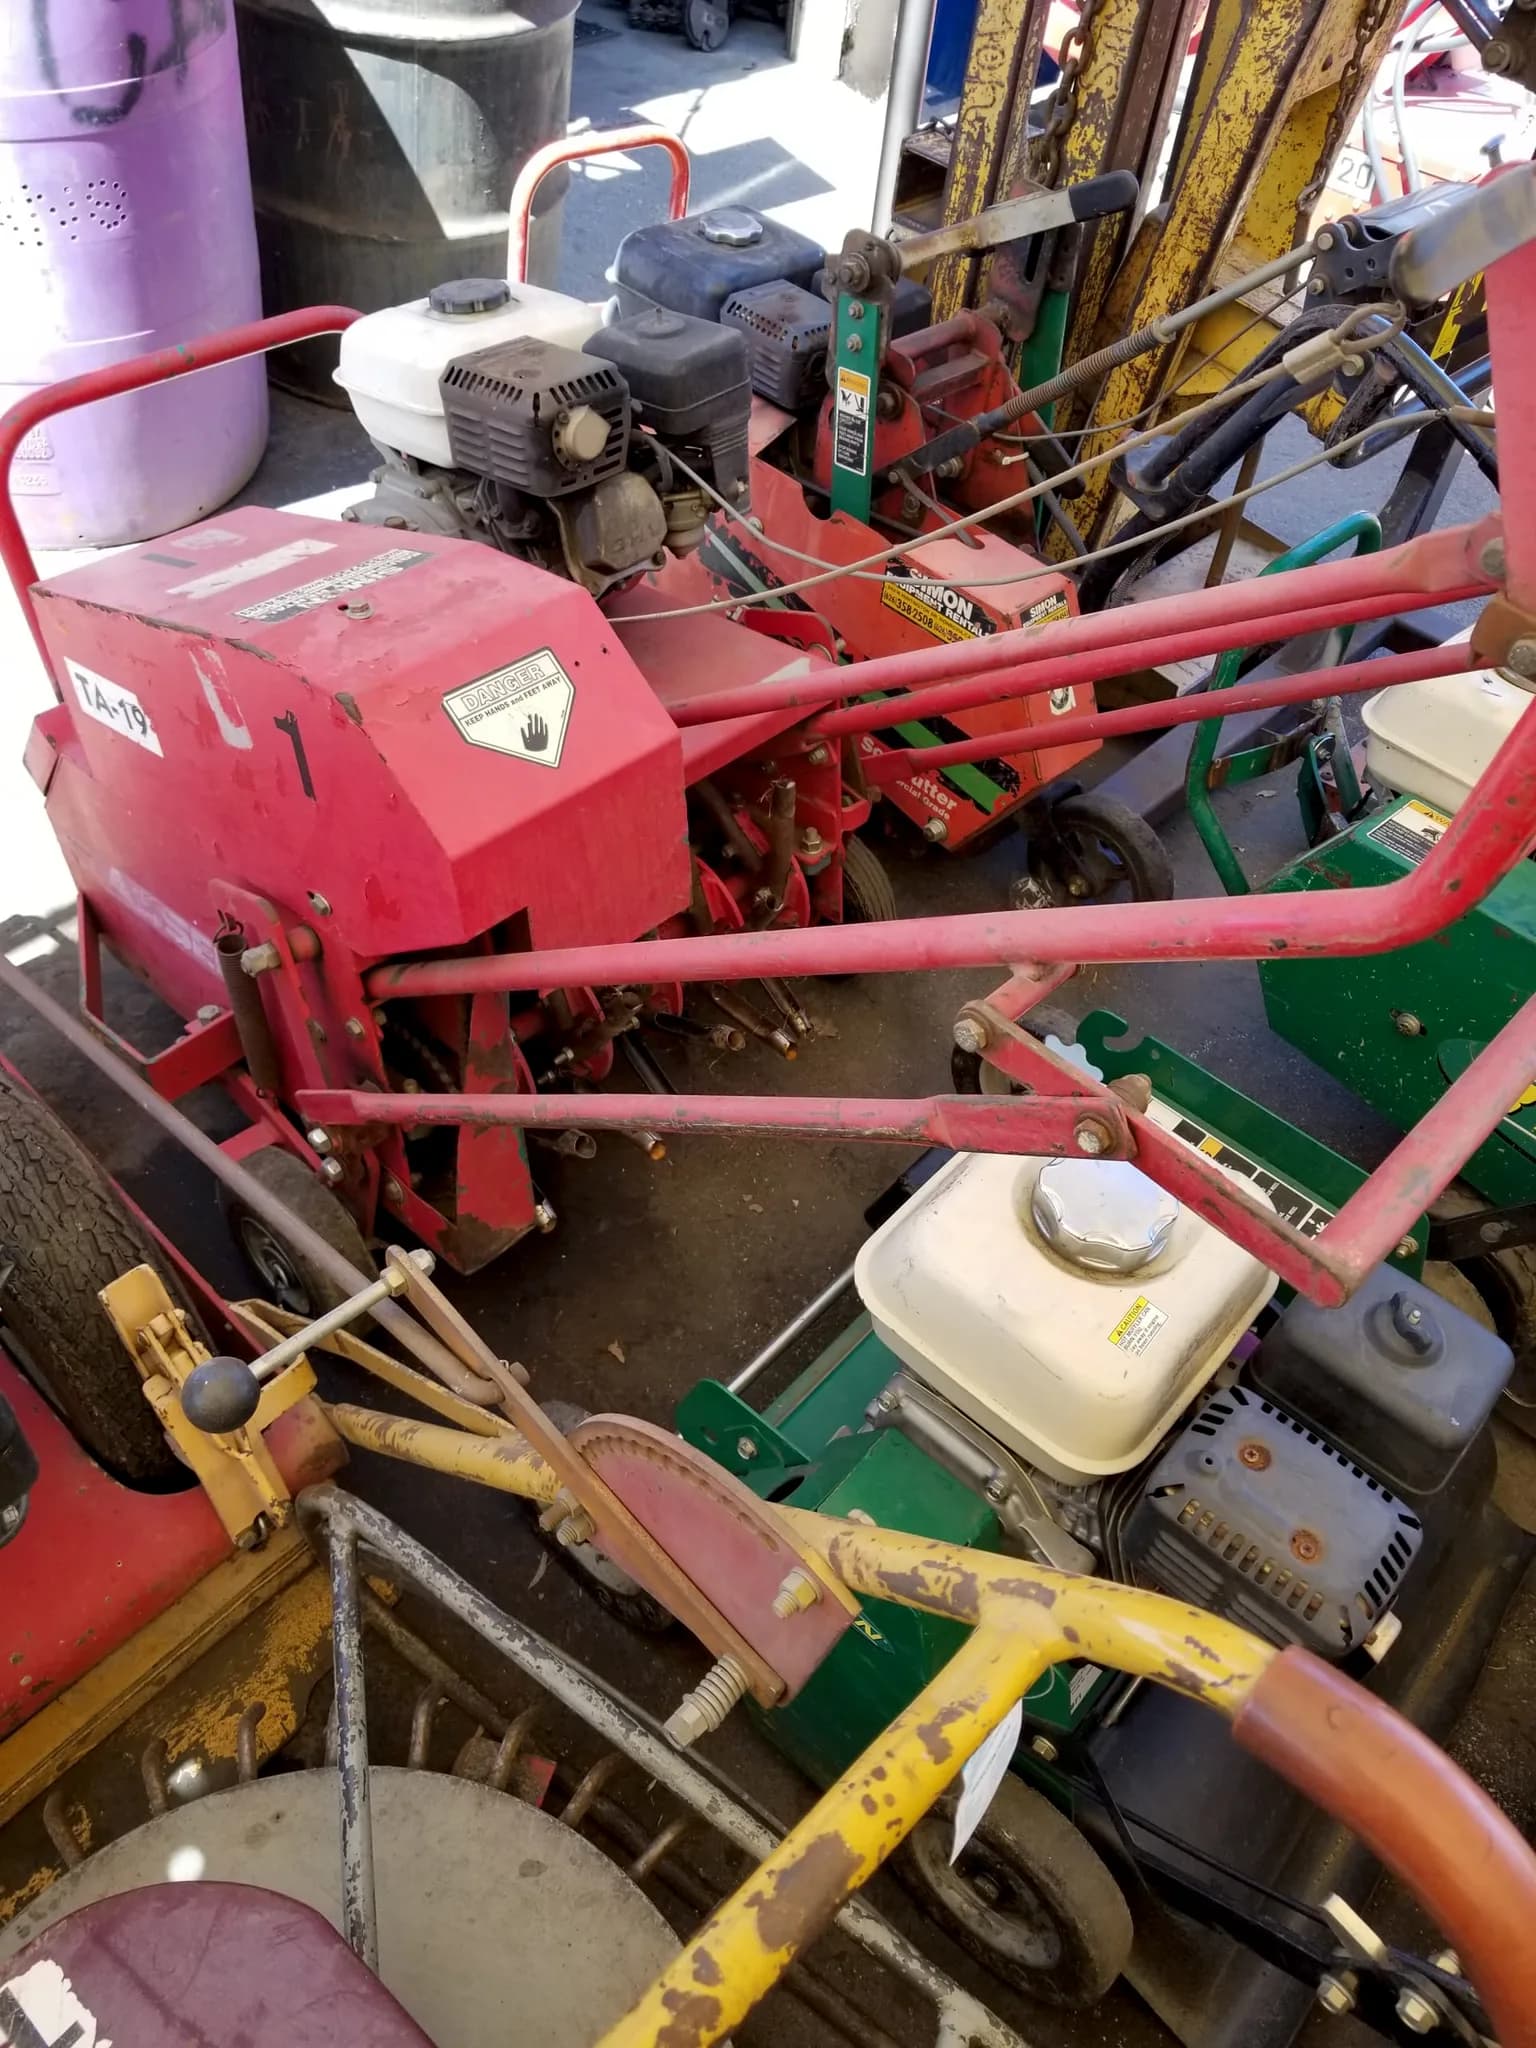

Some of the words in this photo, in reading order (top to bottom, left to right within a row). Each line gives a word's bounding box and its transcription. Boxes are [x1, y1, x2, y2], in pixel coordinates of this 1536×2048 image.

[1030, 595, 1057, 617] SIMON
[75, 671, 147, 736] TA-19
[461, 663, 545, 712] DANGER
[464, 713, 483, 726] KEEP
[485, 701, 510, 717] HANDS
[511, 696, 524, 705] and
[523, 686, 541, 699] FEET
[542, 676, 561, 690] AWAY
[911, 776, 957, 810] utter
[922, 797, 950, 820] Grade
[1120, 1303, 1142, 1330] CAUTION
